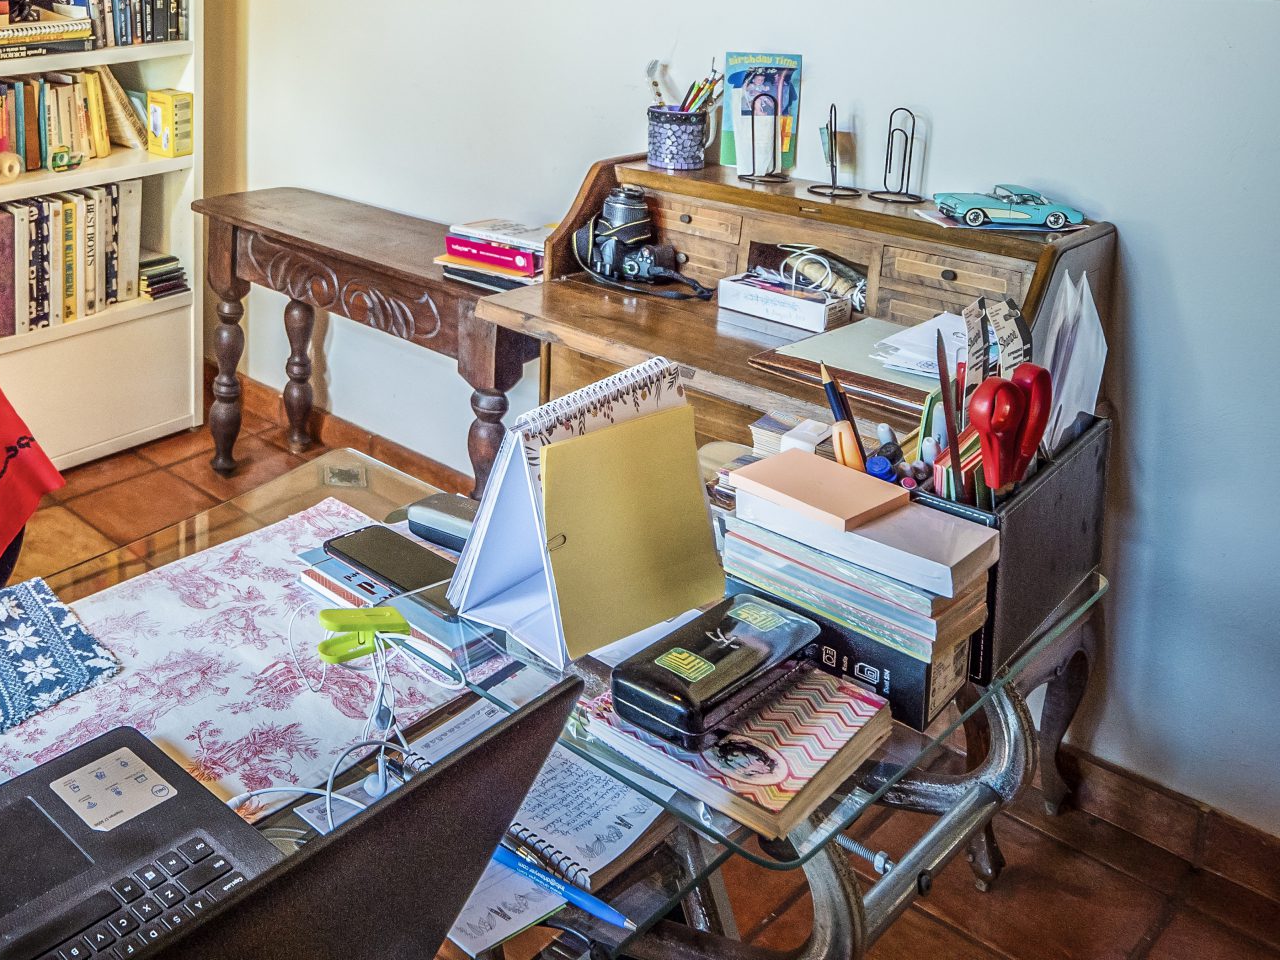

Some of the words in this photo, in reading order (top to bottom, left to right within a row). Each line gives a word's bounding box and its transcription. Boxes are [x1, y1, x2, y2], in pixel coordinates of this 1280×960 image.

[86, 203, 95, 232] BEST
[86, 233, 95, 267] BOATS
[165, 889, 173, 899] Z
[142, 903, 151, 913] X
[194, 900, 203, 909] A
[118, 918, 128, 927] C
[172, 915, 181, 924] S
[95, 933, 105, 942] V
[149, 930, 158, 939] D
[70, 948, 79, 956] B
